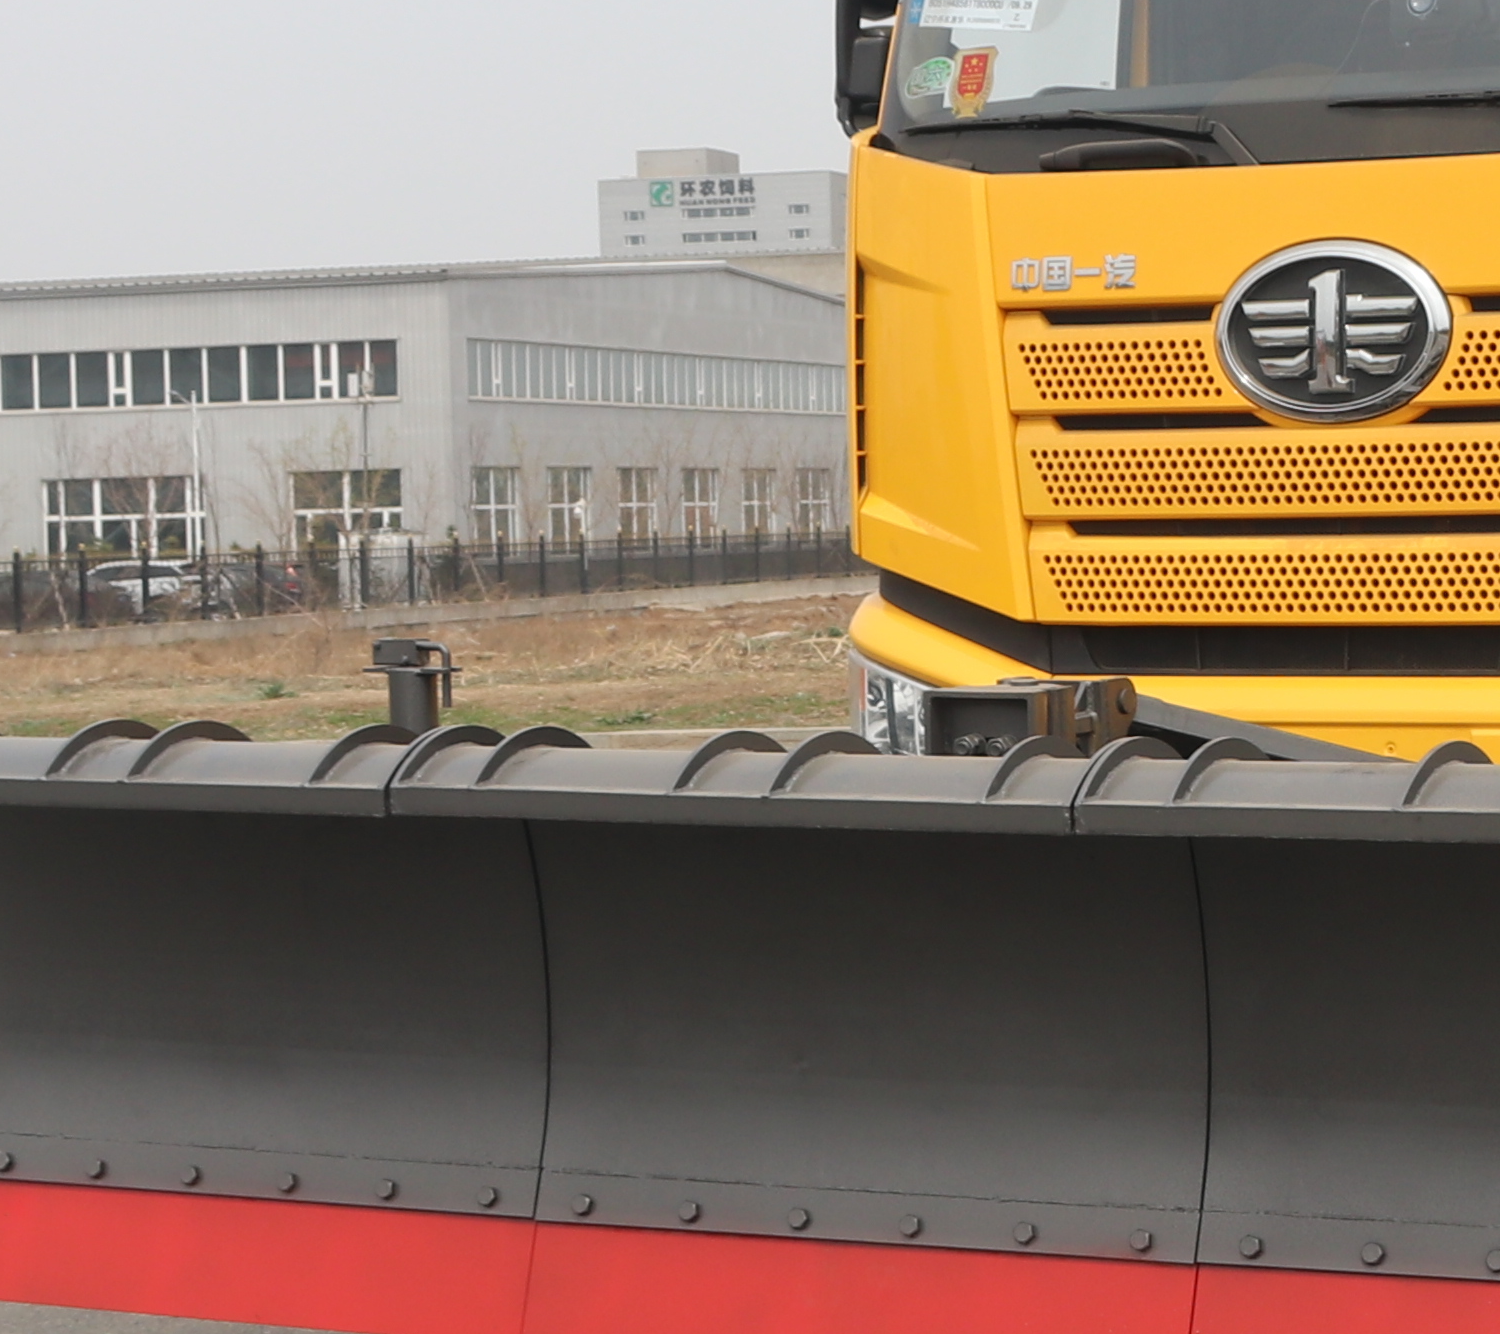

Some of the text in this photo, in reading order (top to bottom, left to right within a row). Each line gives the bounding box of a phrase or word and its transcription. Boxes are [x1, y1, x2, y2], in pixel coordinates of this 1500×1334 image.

[680, 177, 755, 197] 环农饲料
[679, 198, 704, 206] HUAN
[733, 196, 756, 204] FEED
[1011, 254, 1136, 291] 中国一汽
